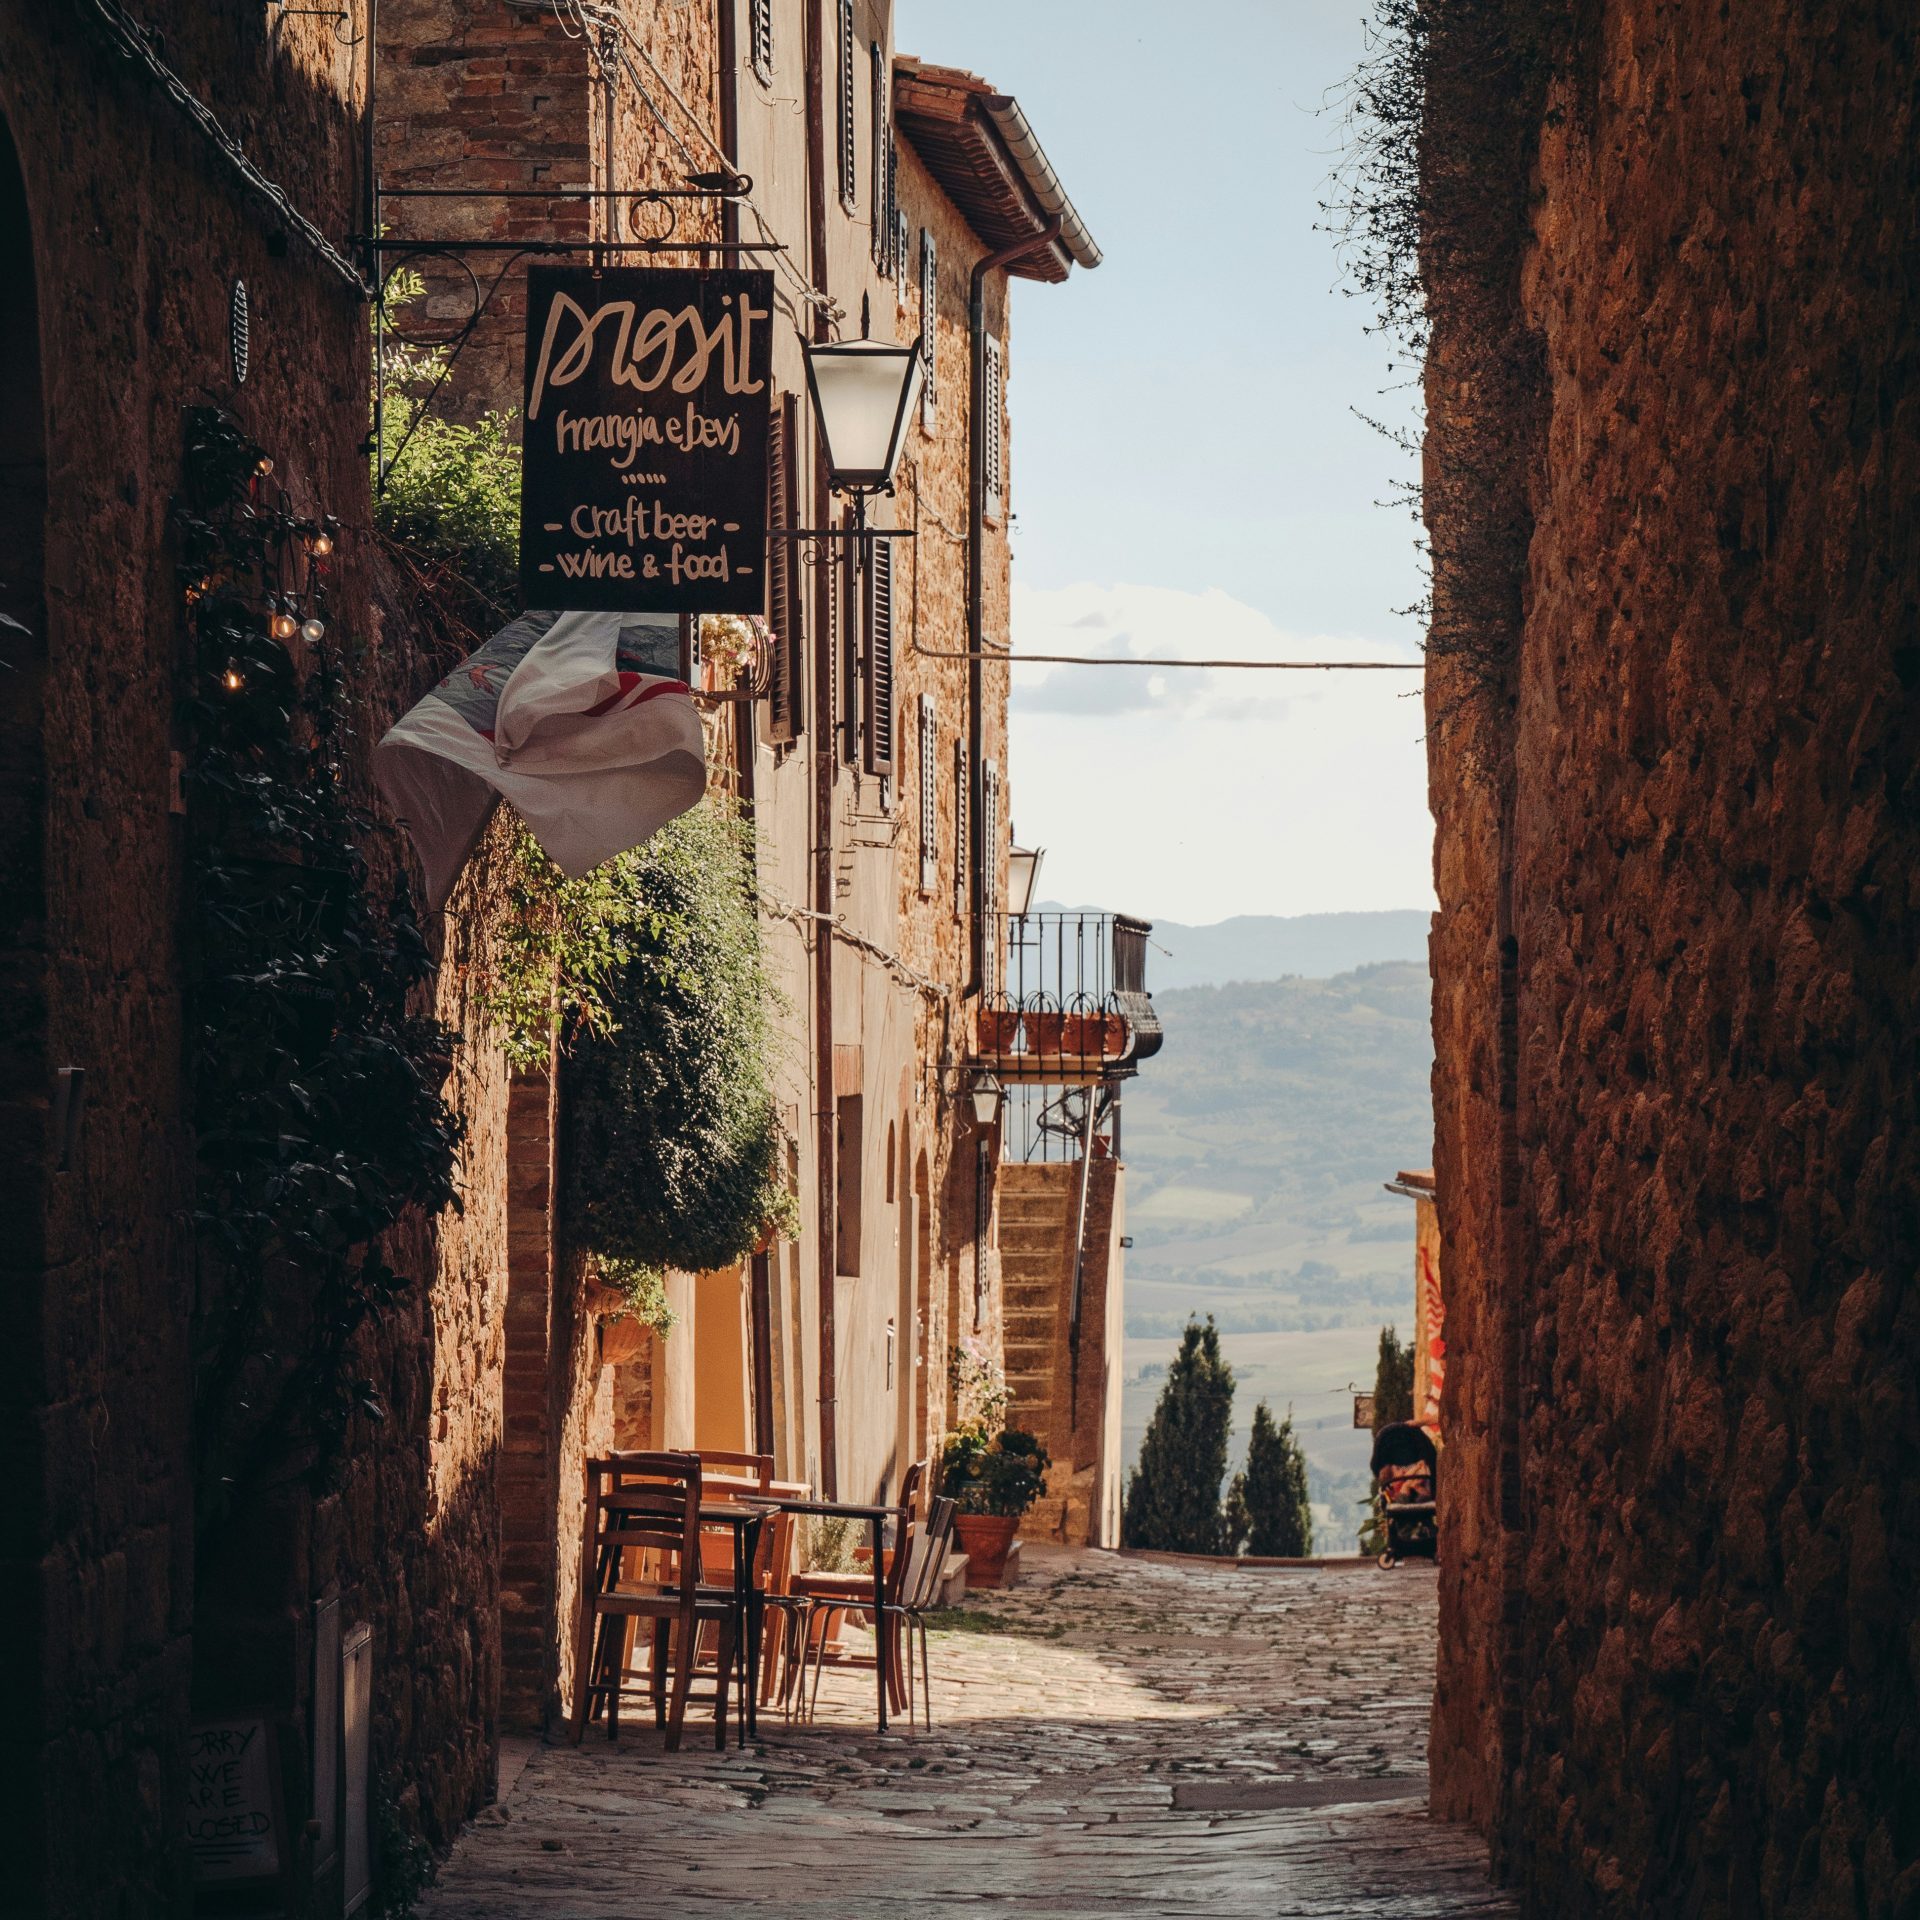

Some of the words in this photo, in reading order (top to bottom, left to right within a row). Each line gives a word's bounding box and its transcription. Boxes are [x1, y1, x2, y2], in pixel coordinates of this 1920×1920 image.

[556, 407, 664, 469] mangia
[665, 415, 684, 445] e
[653, 499, 717, 541] beer
[556, 544, 636, 579] wine
[642, 553, 660, 579] &
[663, 542, 729, 586] food
[190, 1723, 257, 1757] ORRY
[191, 1760, 243, 1784] WE
[186, 1812, 271, 1841] LOSED
